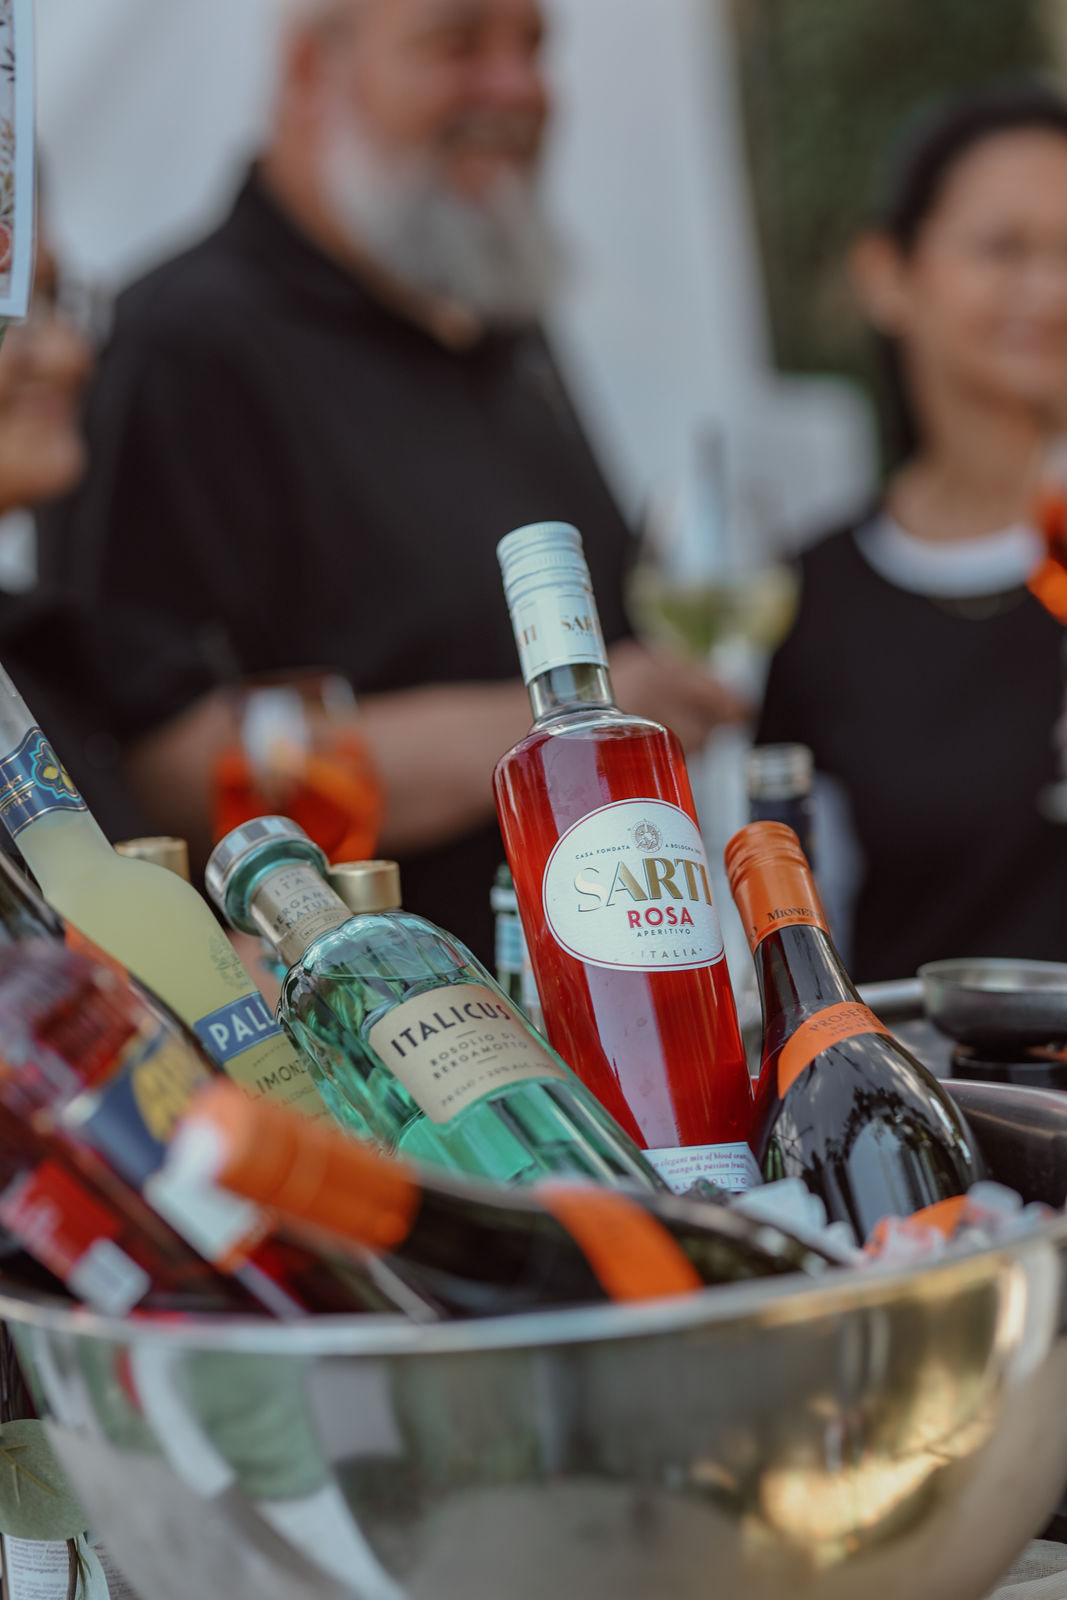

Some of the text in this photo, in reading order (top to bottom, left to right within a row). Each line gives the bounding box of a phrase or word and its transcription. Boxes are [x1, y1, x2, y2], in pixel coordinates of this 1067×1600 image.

[575, 851, 593, 860] CASA
[596, 844, 631, 855] FONDATA
[573, 857, 712, 913] SARTI
[627, 906, 695, 929] ROSA
[636, 927, 691, 938] APERITIVO
[390, 1002, 511, 1058] ITALICUS
[430, 1033, 494, 1066] ROSOLIO
[432, 1041, 528, 1079] BERGAMOTTO
[689, 1153, 703, 1162] mix
[704, 1152, 713, 1162] of
[714, 1151, 733, 1160] blood
